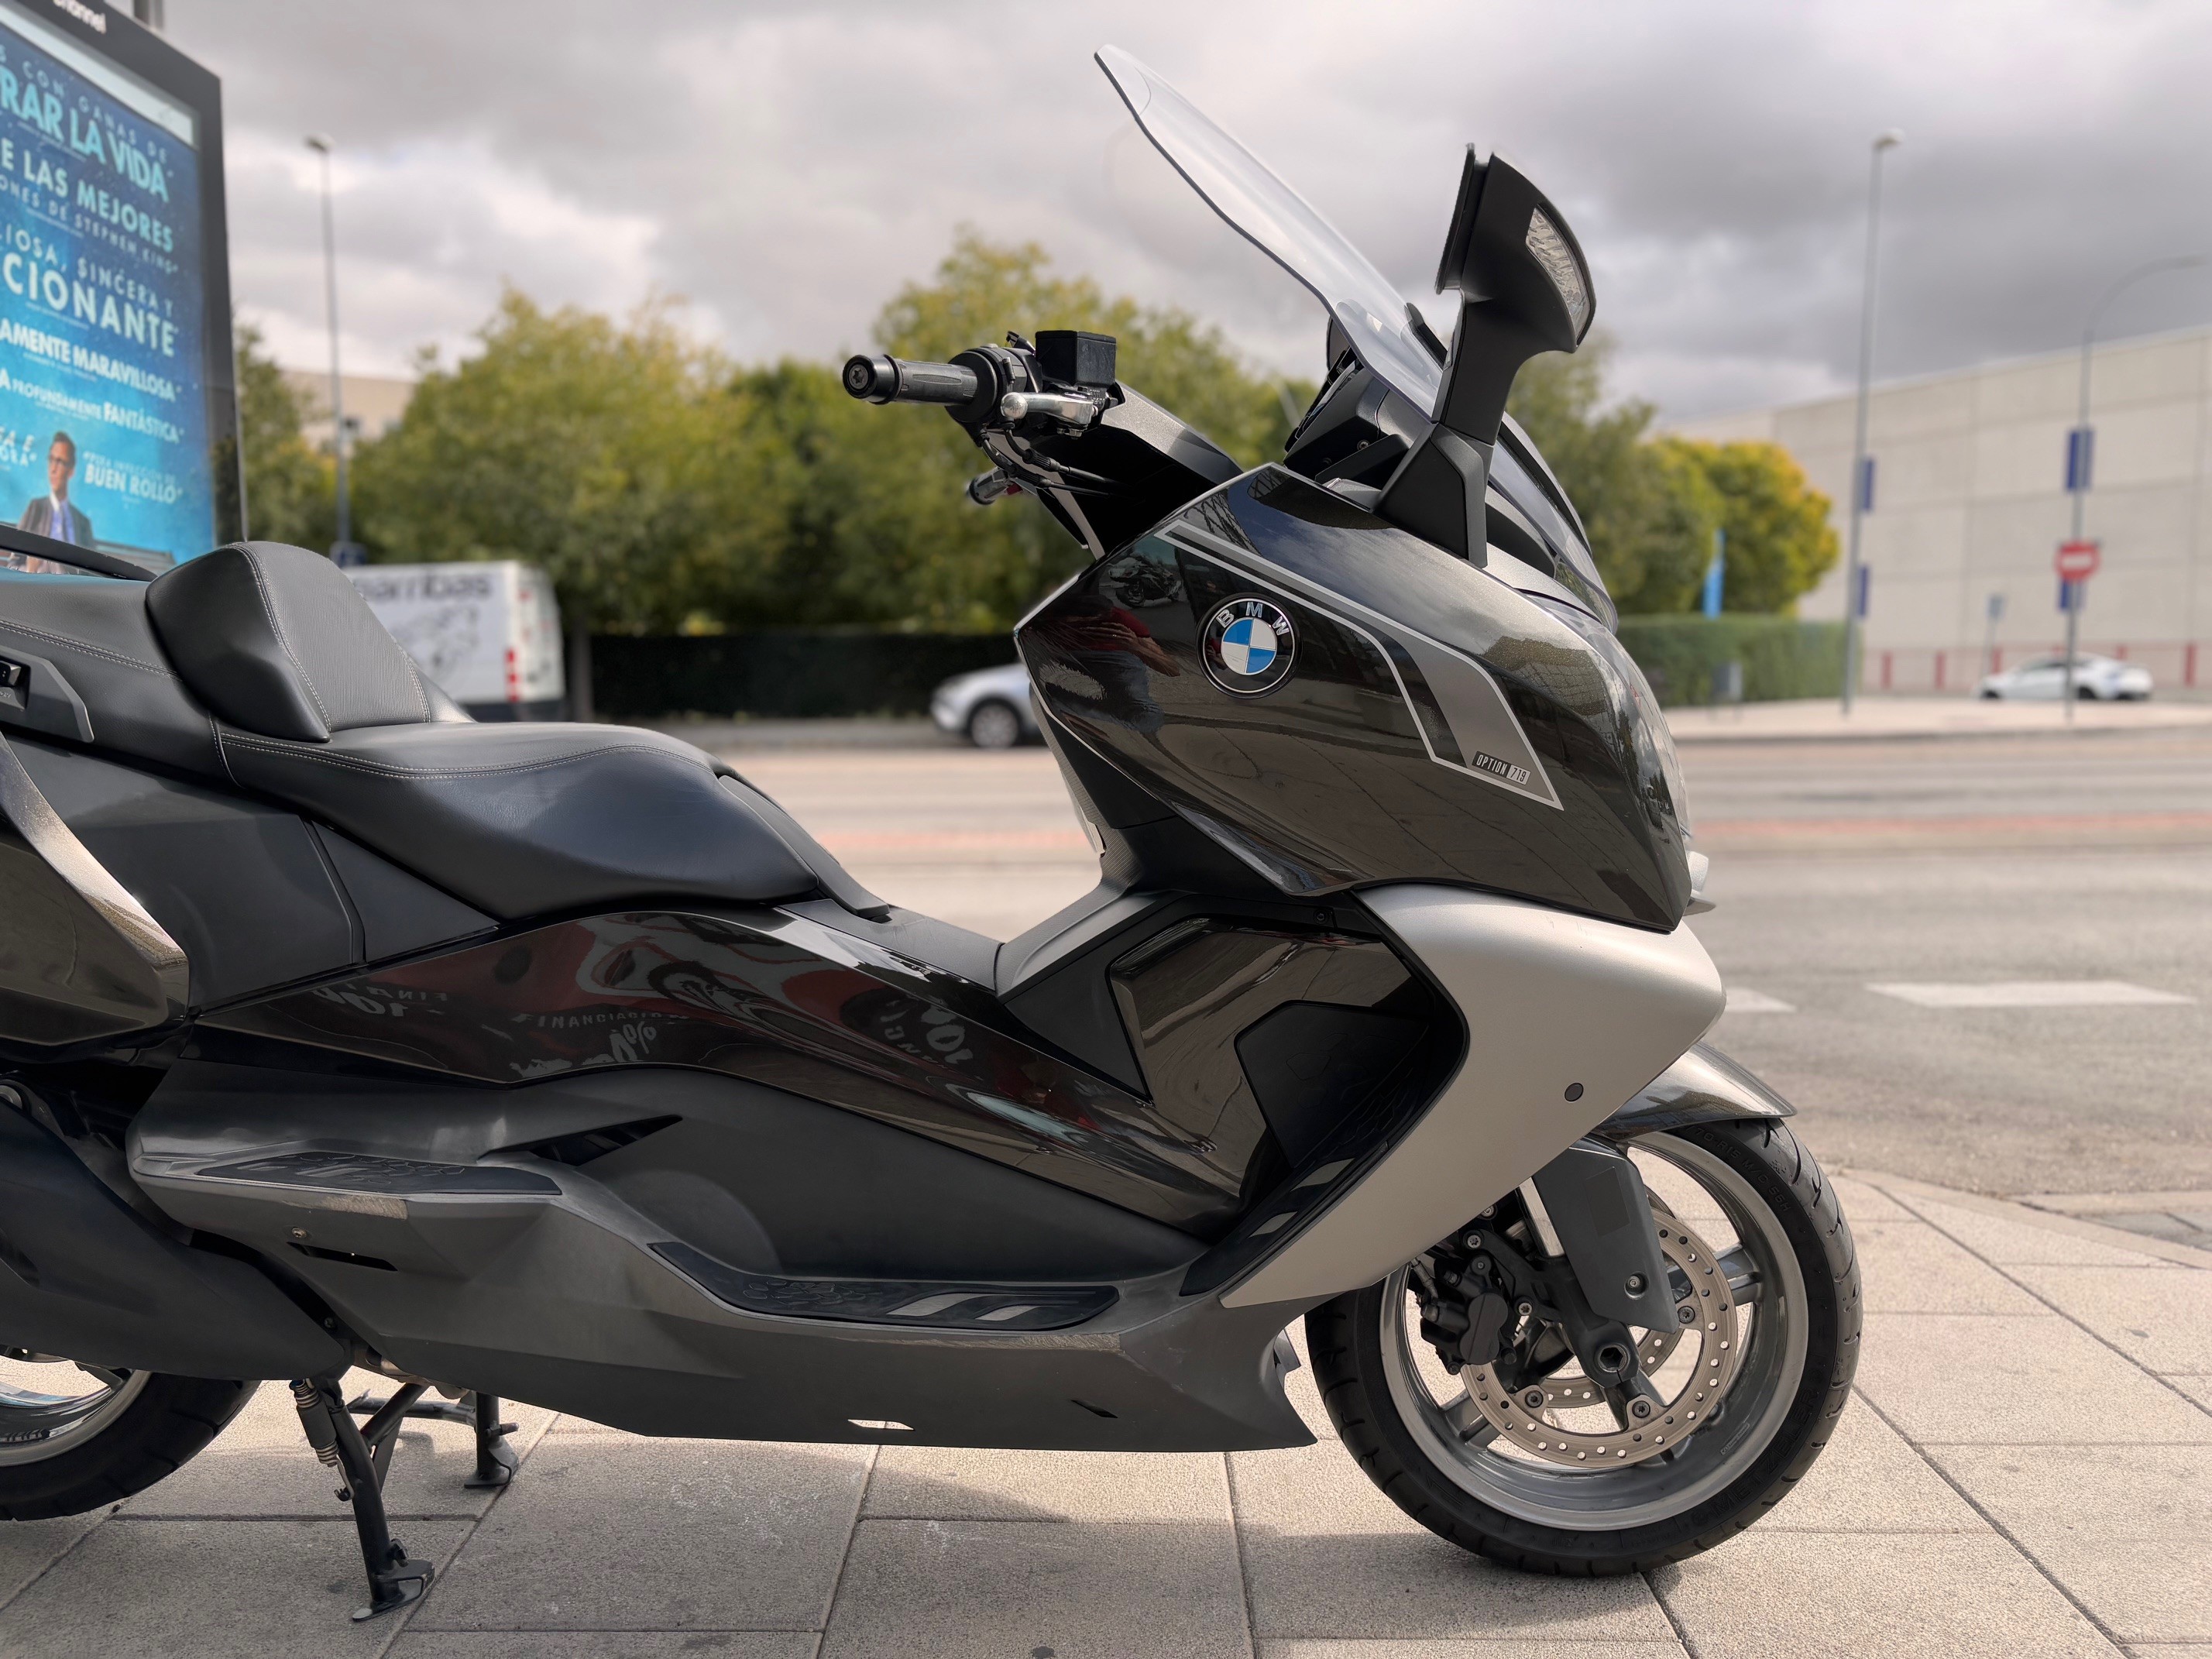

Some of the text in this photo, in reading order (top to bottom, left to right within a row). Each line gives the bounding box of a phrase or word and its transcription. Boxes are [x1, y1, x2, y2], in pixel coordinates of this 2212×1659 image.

[22, 60, 64, 98] CON
[78, 95, 136, 146] GANAS
[147, 141, 167, 164] DE
[70, 107, 107, 166] LA
[23, 149, 68, 198] LAS
[77, 179, 173, 252] MEJORES
[48, 200, 68, 222] DE
[75, 212, 137, 256] STEPHEN
[0, 223, 67, 273] IOSA,
[78, 256, 158, 311] SINCERA
[164, 297, 173, 318] Y
[0, 317, 71, 365] AMENTE
[84, 462, 126, 493] BUEN
[1215, 601, 1290, 636] BMW
[1475, 754, 1527, 782] OPTION 719
